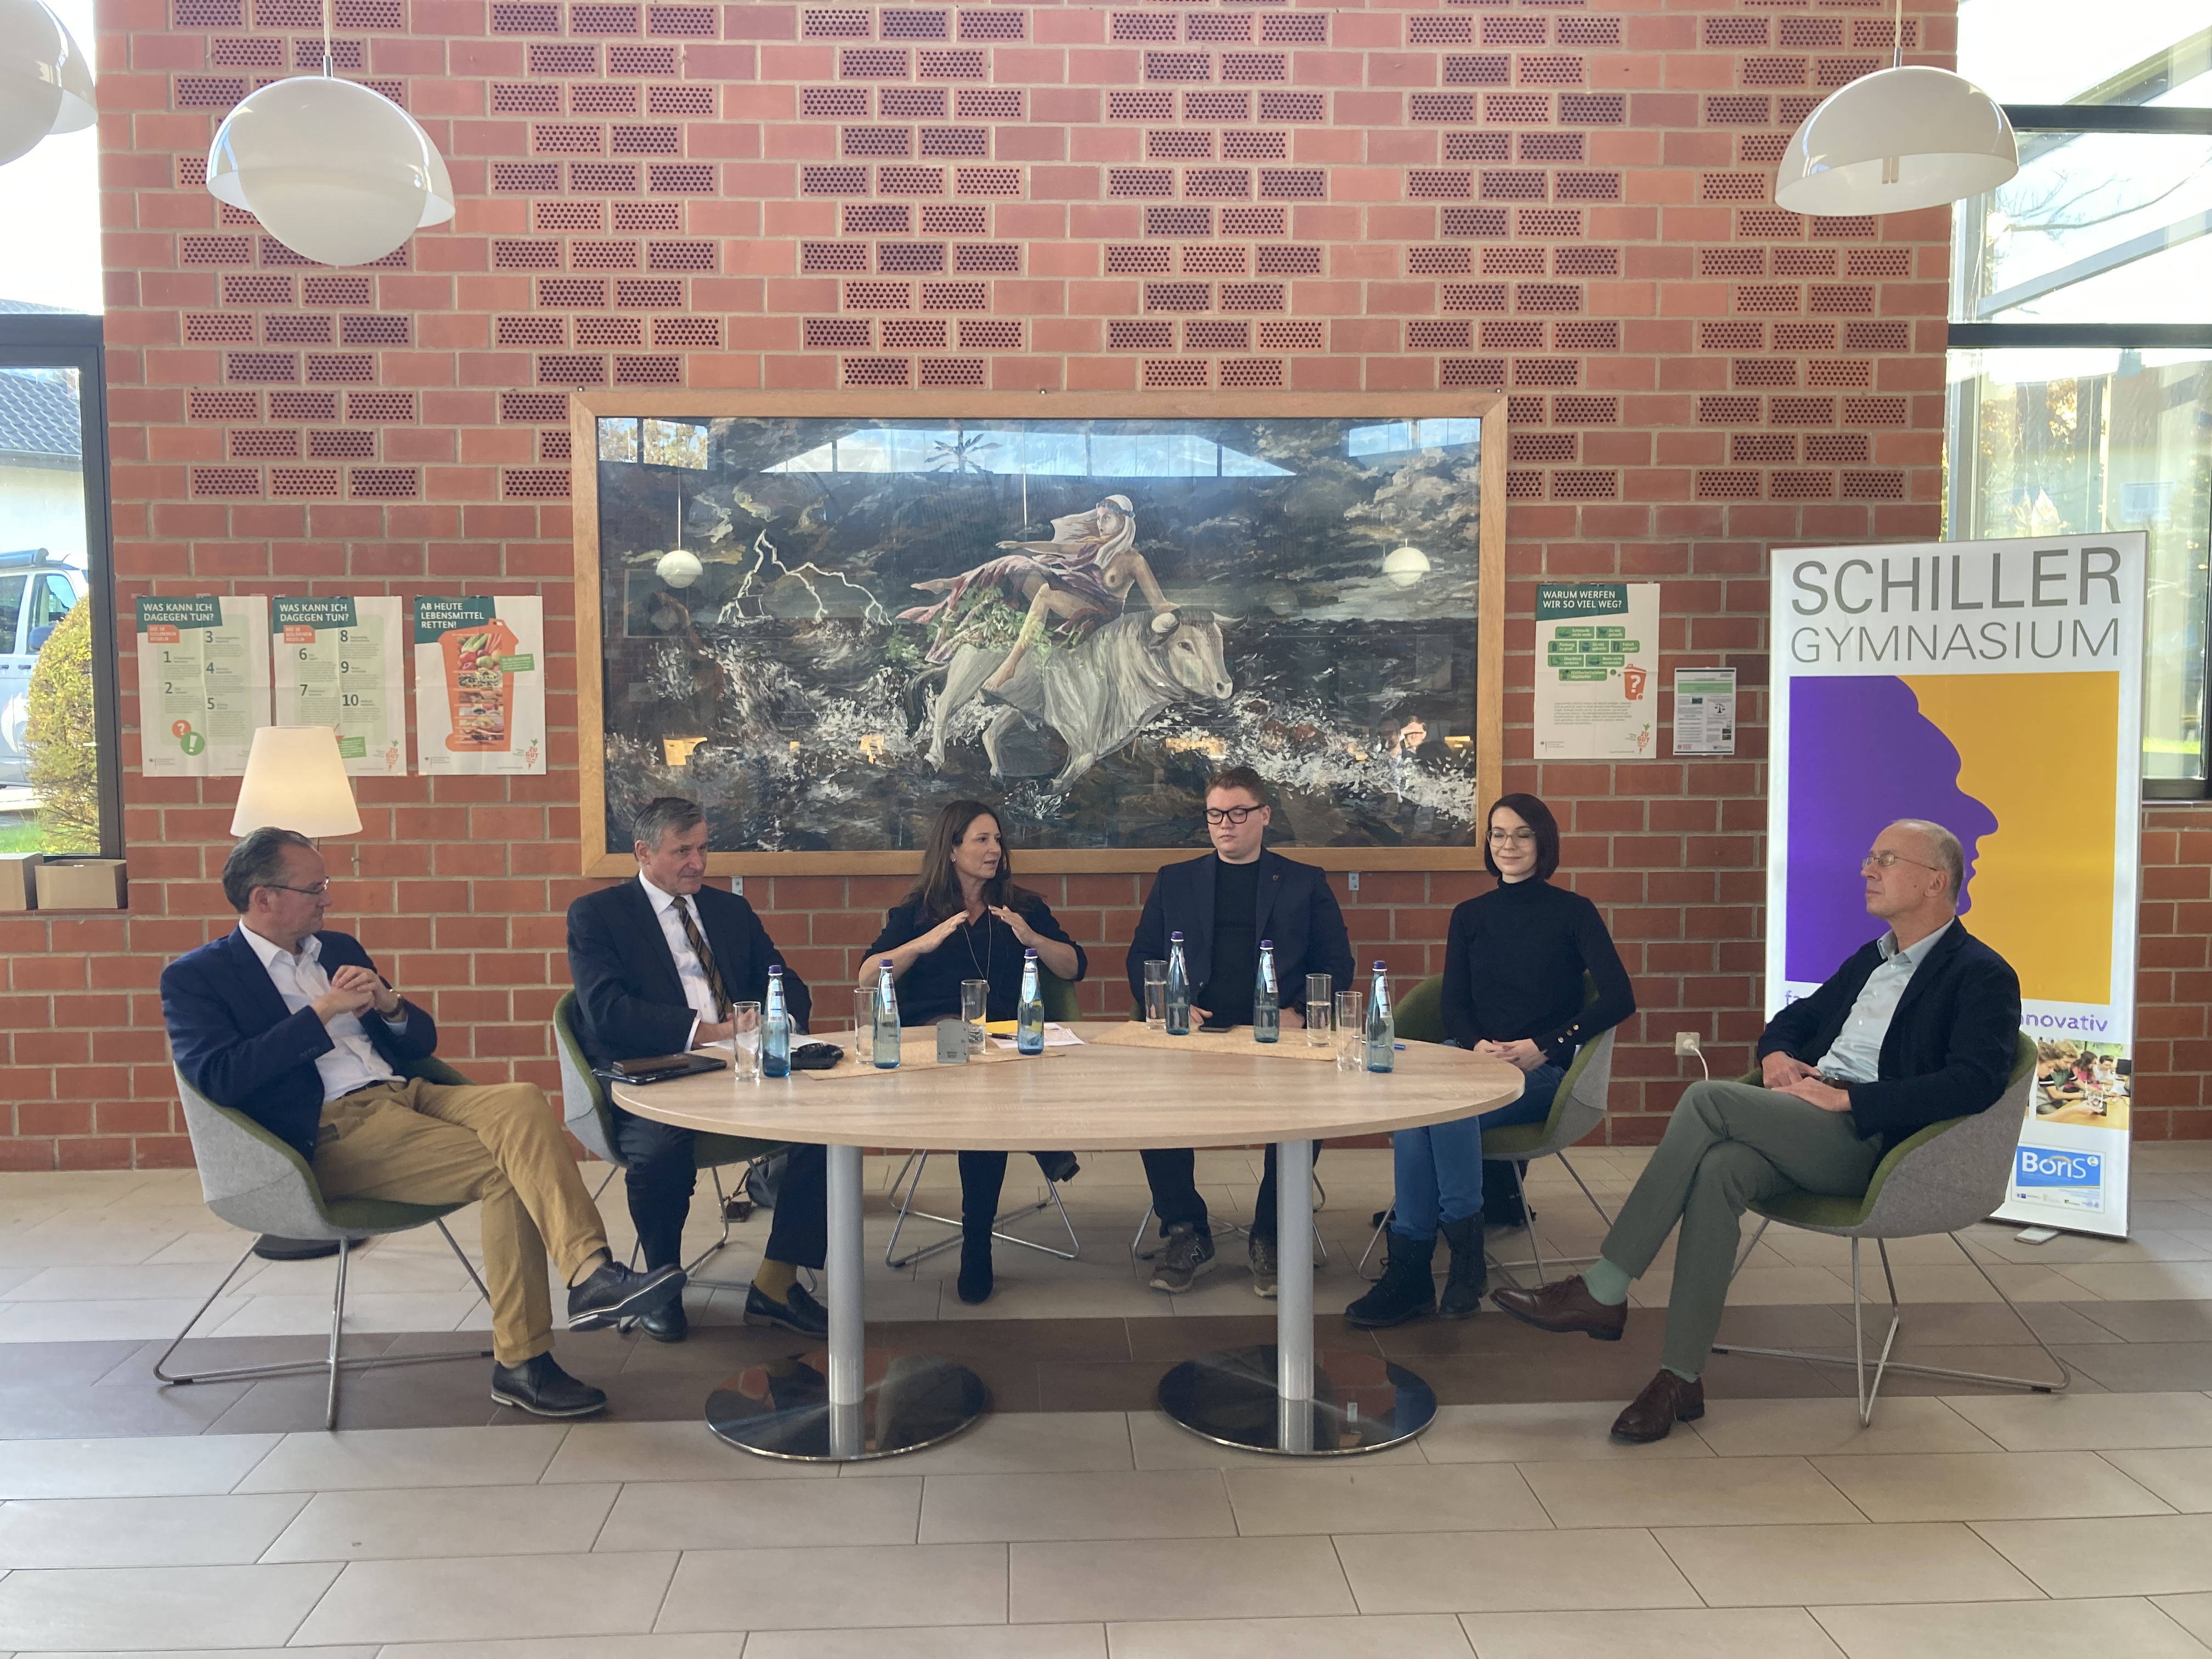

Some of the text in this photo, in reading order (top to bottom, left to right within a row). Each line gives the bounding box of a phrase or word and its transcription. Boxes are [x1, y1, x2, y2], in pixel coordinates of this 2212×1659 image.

[1791, 547, 2121, 616] SCHILLER
[1543, 590, 1615, 599] WARUM WERFEN
[143, 603, 212, 612] WAS KANN ICH
[280, 603, 347, 612] WAS KANN ICH
[420, 602, 462, 611] AB HEUTE
[1598, 600, 1622, 608] WEG?
[144, 613, 214, 621] DAGEGEN TUN?
[280, 613, 349, 622] DAGEGEN TUN?
[421, 620, 456, 629] RETTEN!
[205, 630, 213, 643] 3
[340, 630, 348, 642] 8
[1791, 618, 2119, 663] GYMNASIUM
[163, 651, 171, 663] 1
[299, 648, 307, 660] 6
[206, 662, 215, 674] 4
[341, 661, 349, 673] 9
[165, 682, 173, 694] 2
[300, 684, 308, 696] 7
[207, 697, 215, 709] 5
[342, 694, 359, 706] 10
[2022, 1151, 2086, 1179] BoriS
